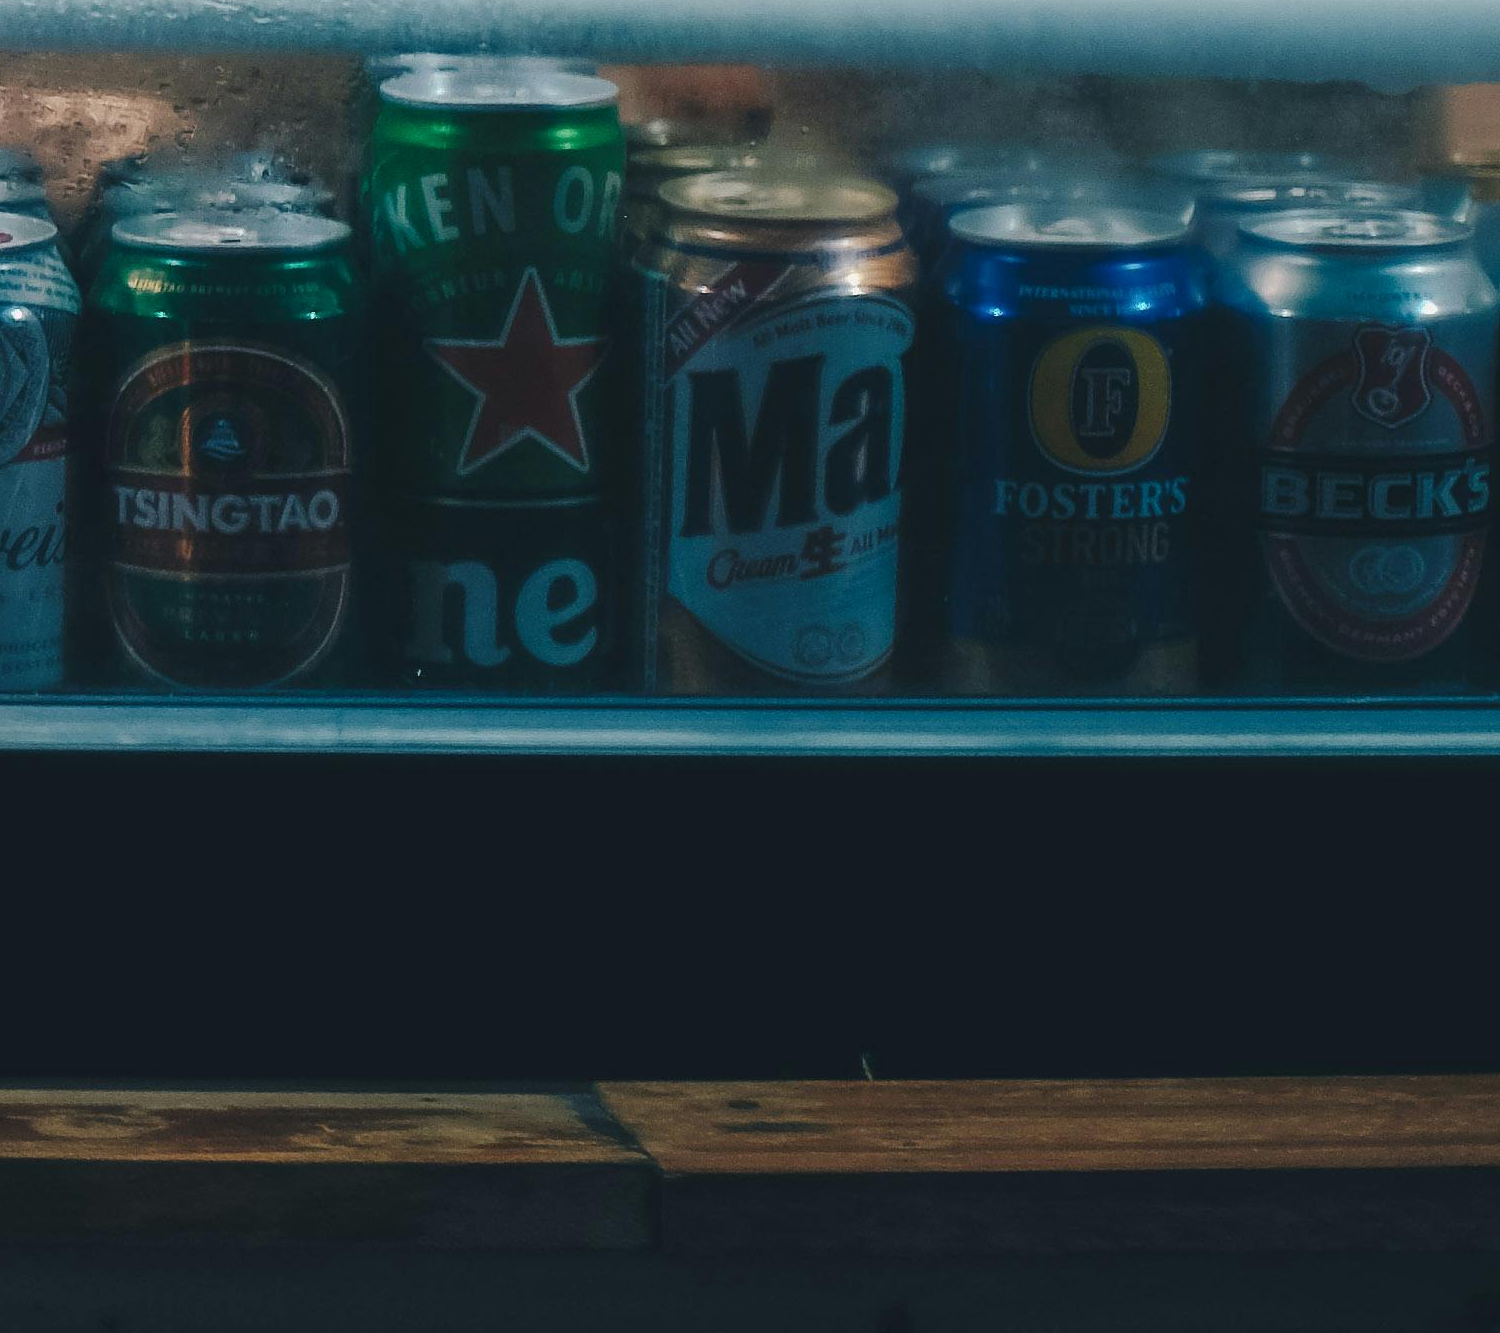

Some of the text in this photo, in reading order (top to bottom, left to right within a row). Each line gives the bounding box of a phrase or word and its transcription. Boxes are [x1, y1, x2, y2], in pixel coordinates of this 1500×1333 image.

[114, 486, 343, 535] TSINGTAO
[993, 477, 1190, 520] FOSTER'S
[1260, 457, 1492, 520] BECK'S
